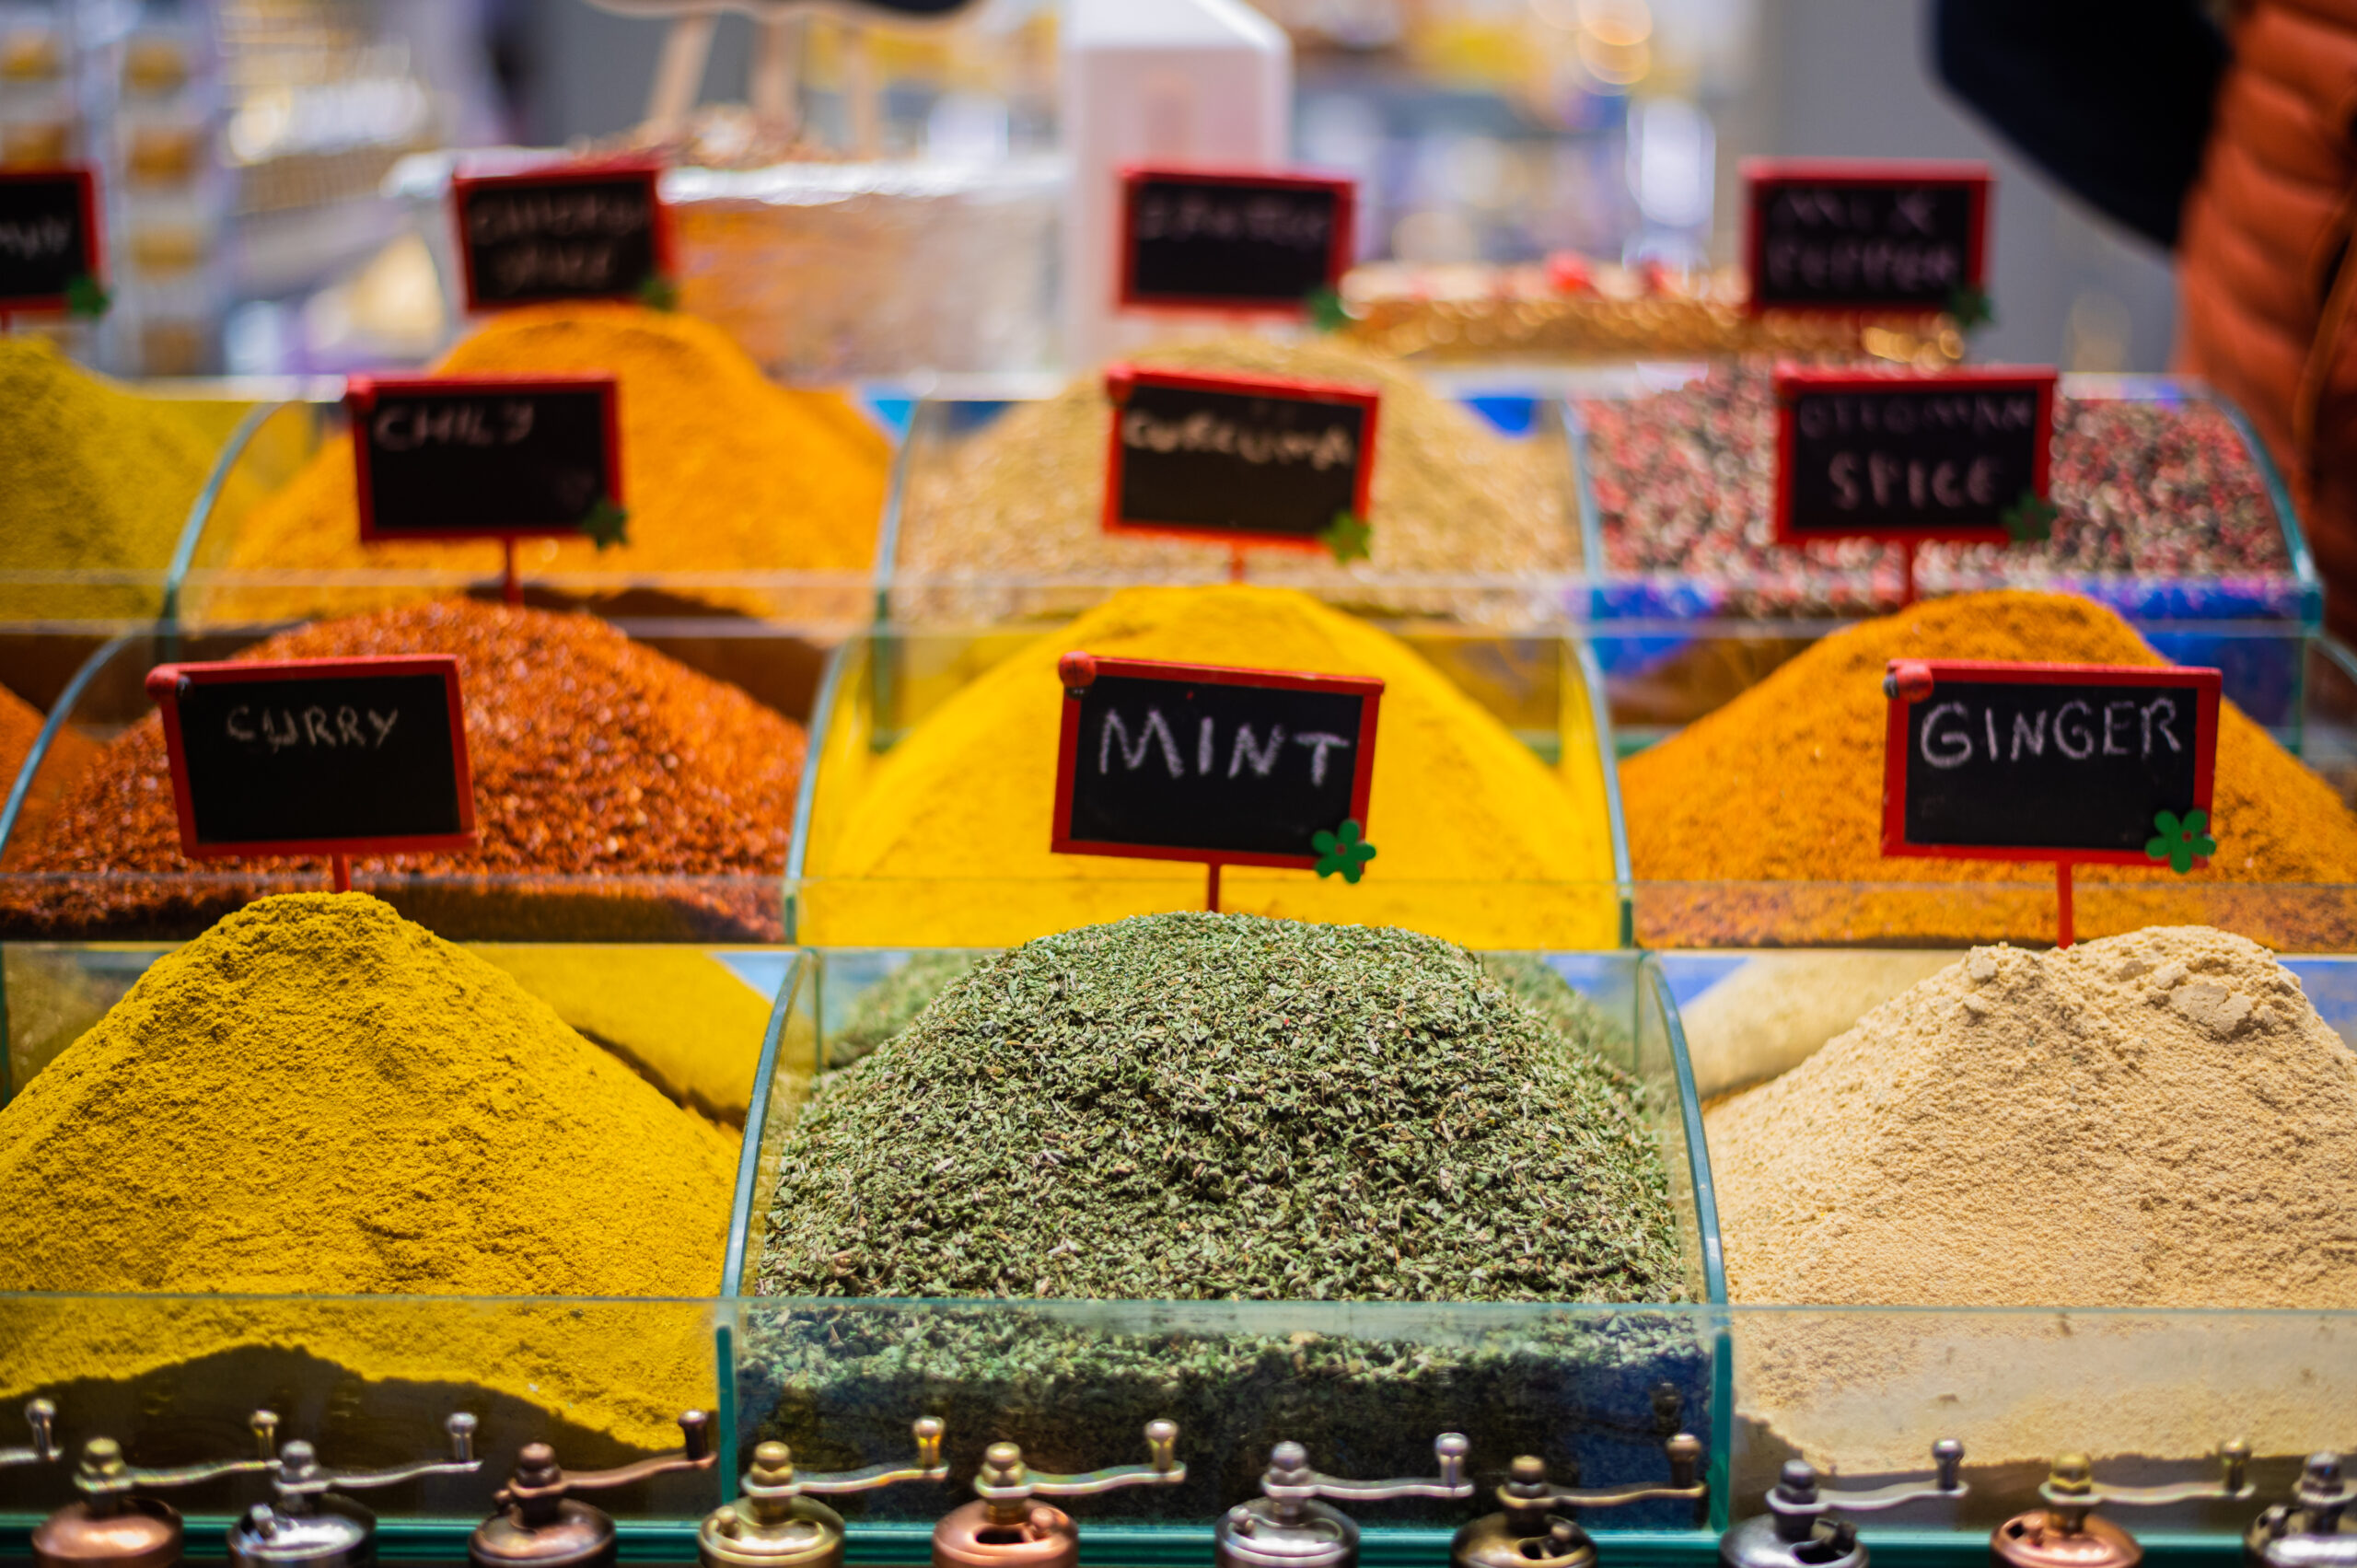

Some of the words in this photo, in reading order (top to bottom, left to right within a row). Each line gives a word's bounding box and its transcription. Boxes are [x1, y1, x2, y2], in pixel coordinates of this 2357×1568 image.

[1828, 449, 2004, 510] SPICE
[226, 704, 399, 754] CURRY
[1099, 707, 1350, 787] MINT
[1921, 696, 2181, 769] GINGER
